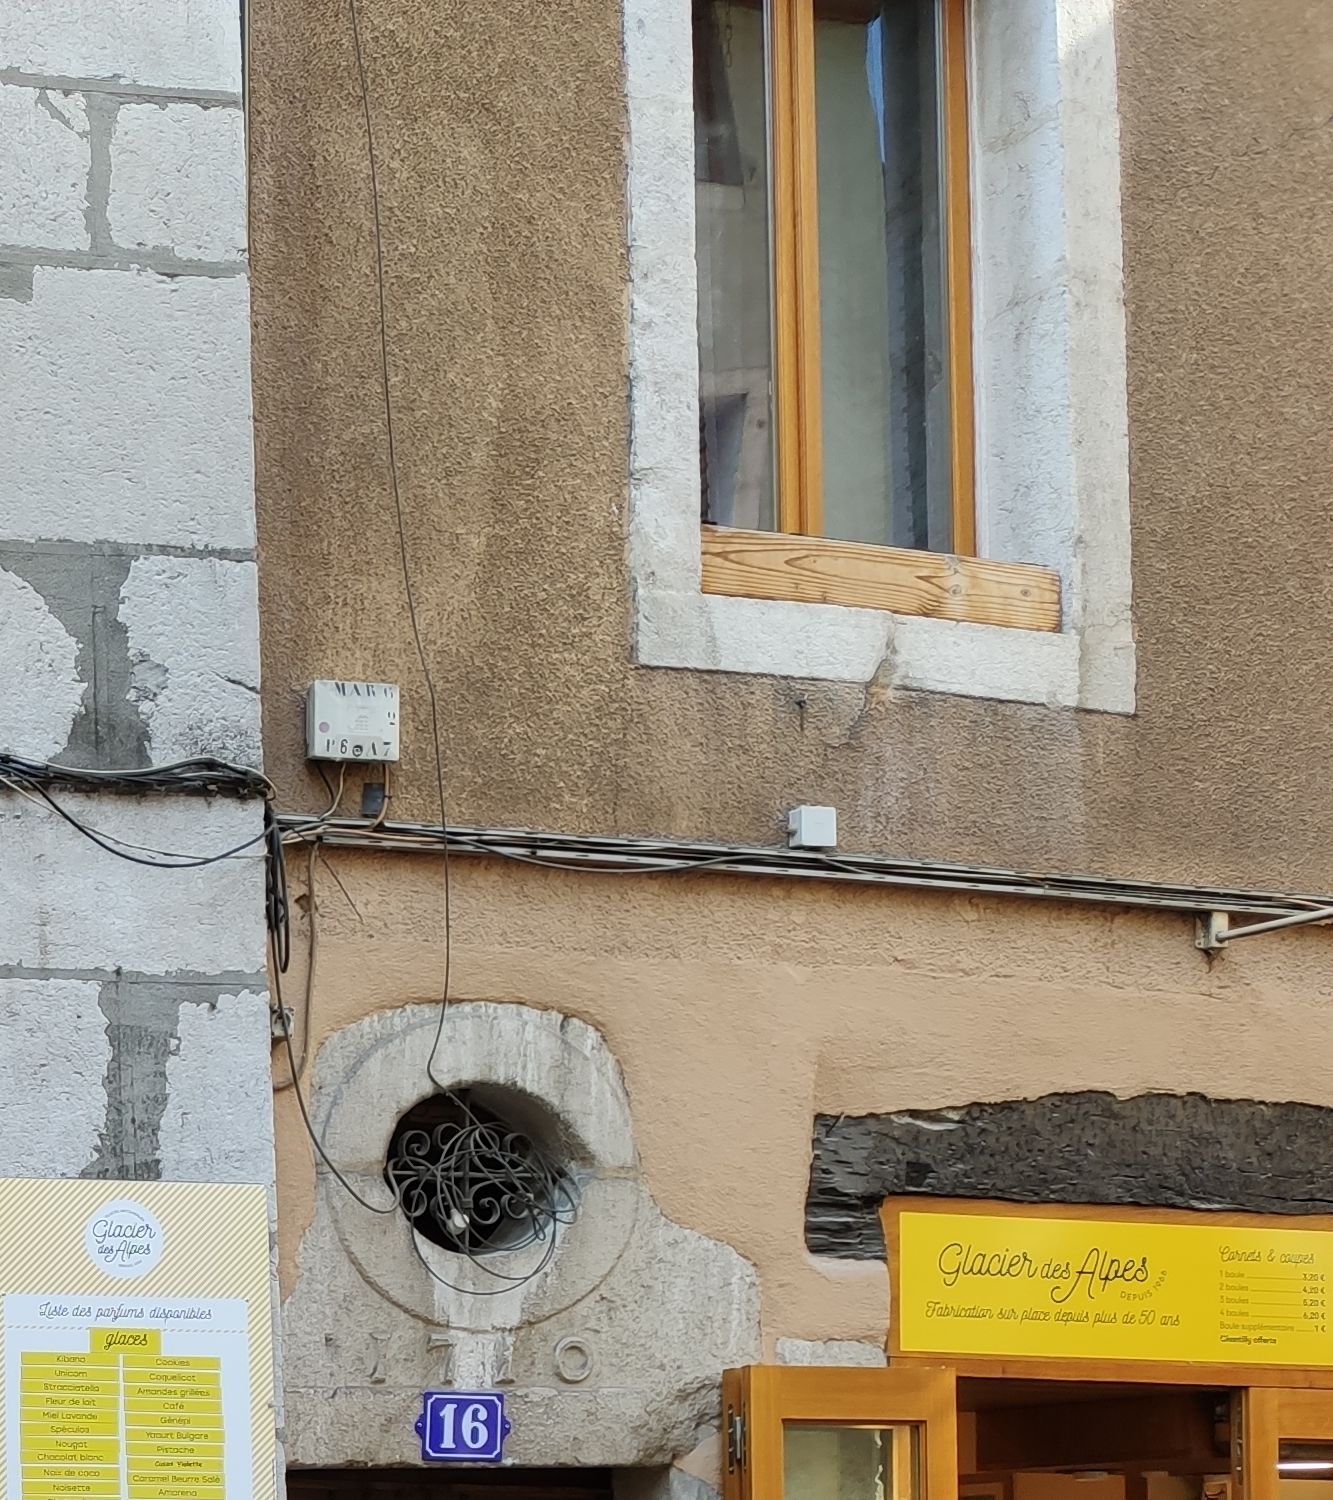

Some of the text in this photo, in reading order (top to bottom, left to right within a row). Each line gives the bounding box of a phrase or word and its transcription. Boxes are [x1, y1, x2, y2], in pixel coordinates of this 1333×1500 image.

[92, 1218, 156, 1244] Glacier
[97, 1240, 151, 1263] des Alpes
[1219, 1245, 1261, 1262] Cornets
[938, 1243, 1038, 1287] Glacier
[1040, 1258, 1071, 1279] des
[1050, 1248, 1149, 1303] Alpes
[39, 1301, 213, 1325] Liste des parfums disponibles
[926, 1300, 1180, 1328] Fabrication sur place depuis plus de 50 ans
[103, 1330, 149, 1350] glaces
[439, 1403, 489, 1449] 16
